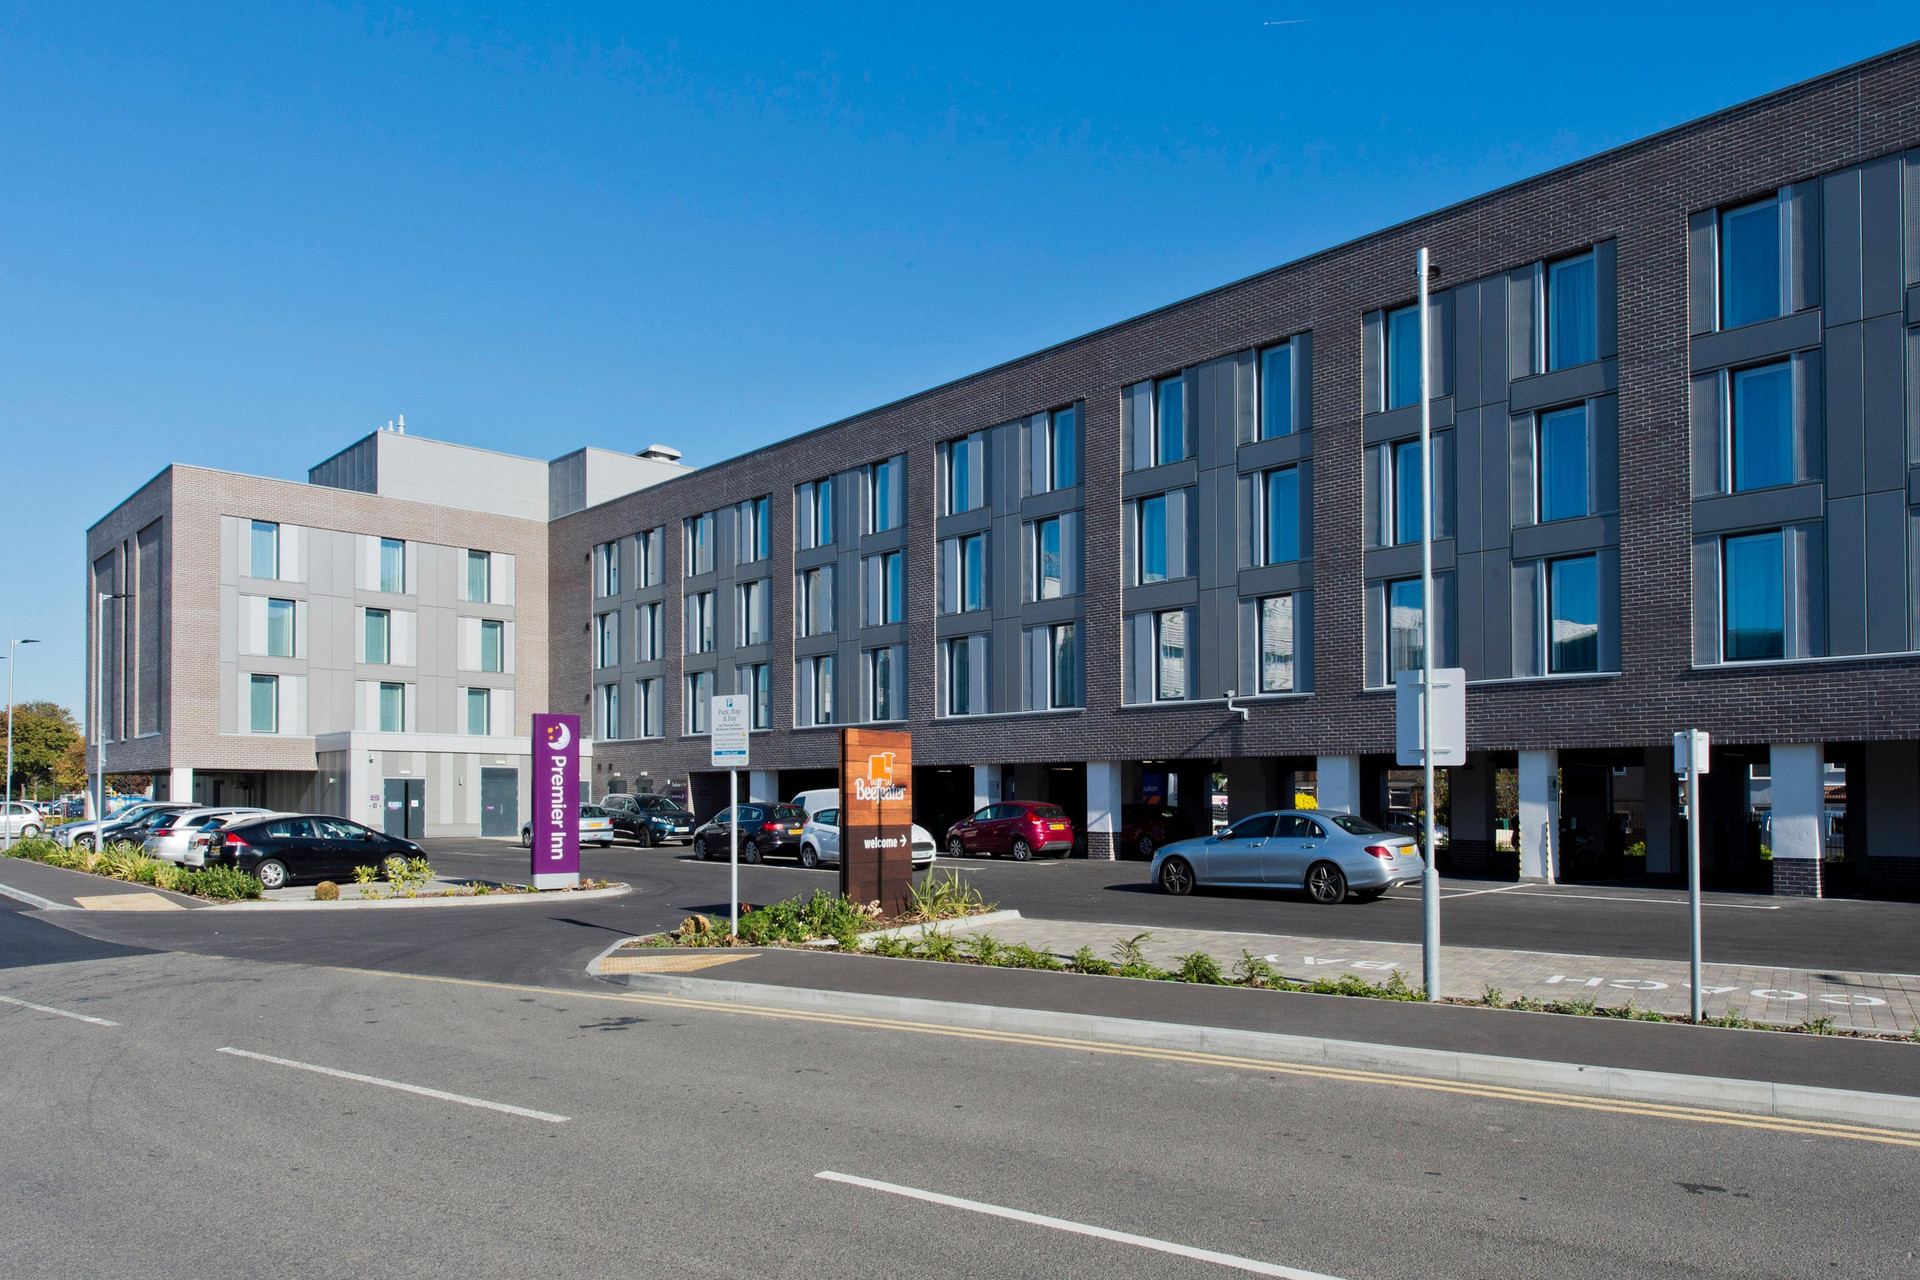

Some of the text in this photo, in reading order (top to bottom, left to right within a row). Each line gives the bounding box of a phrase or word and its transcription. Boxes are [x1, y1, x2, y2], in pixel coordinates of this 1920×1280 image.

[551, 755, 567, 860] Premier Inn
[854, 778, 906, 805] Beefeater
[864, 837, 898, 849] welcome
[1251, 954, 1887, 1006] COACH BAY
